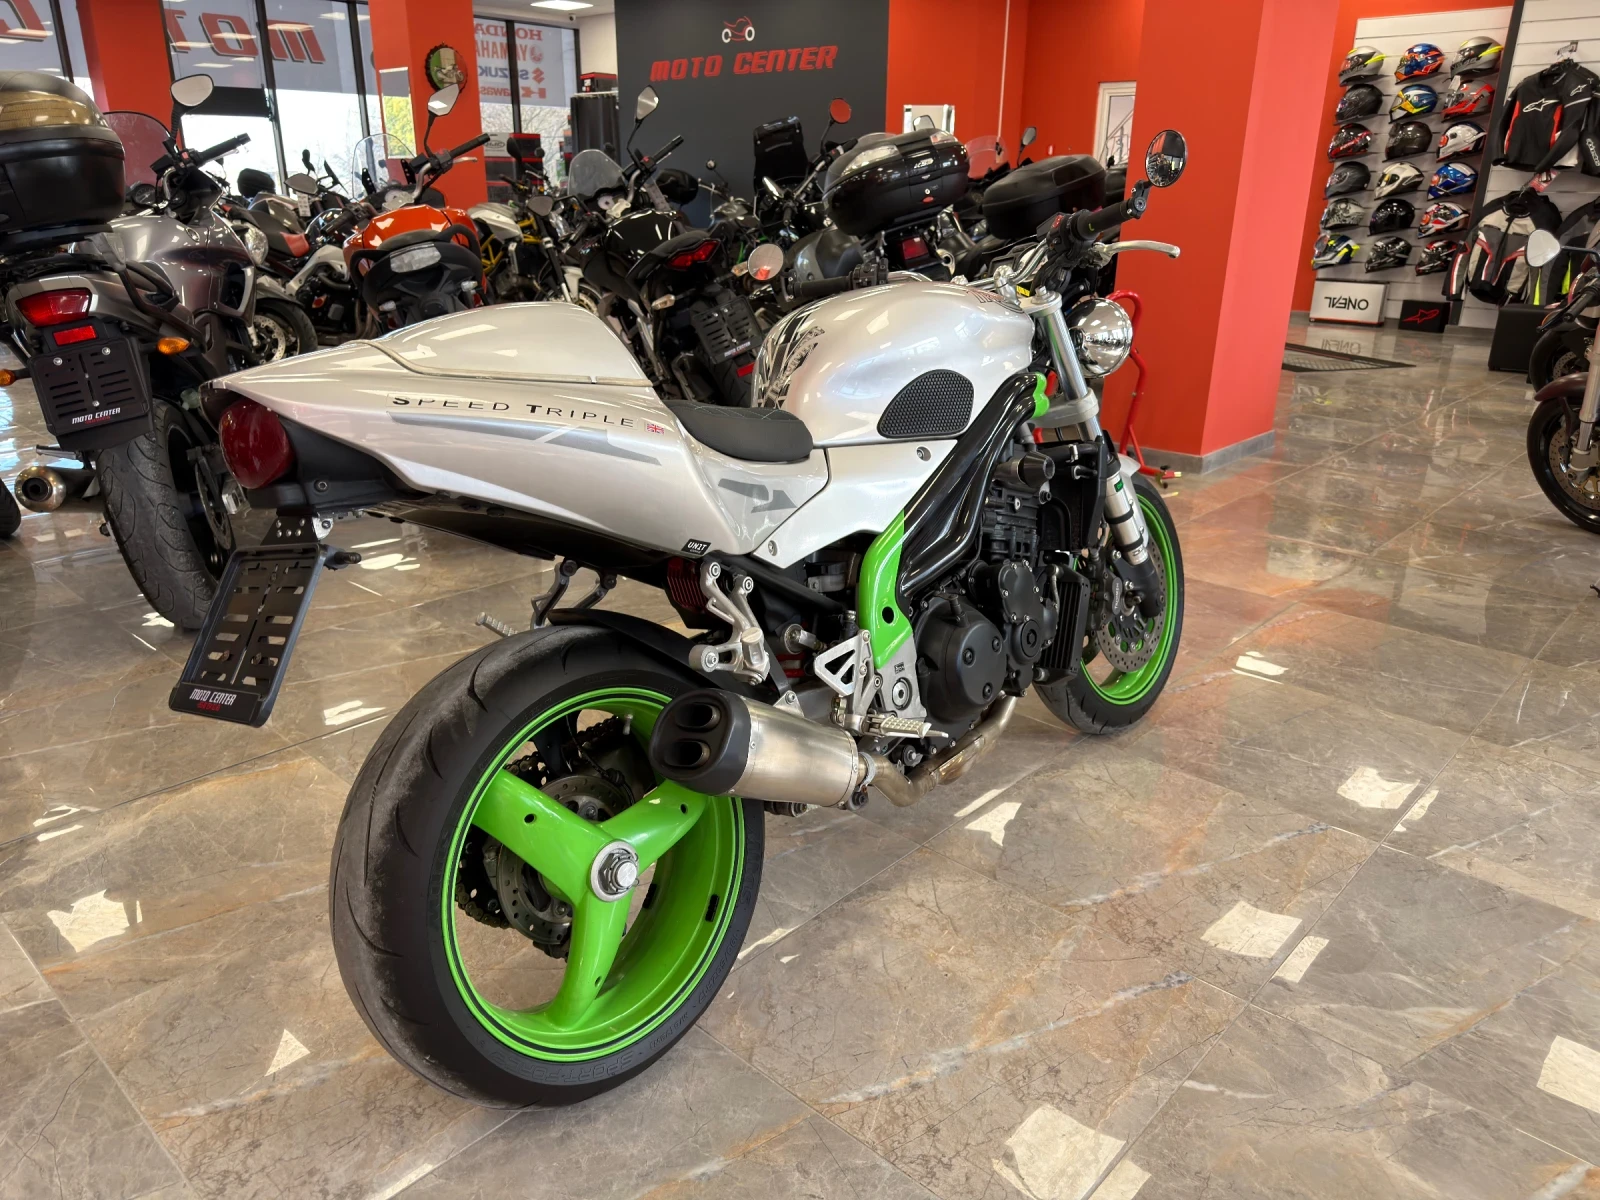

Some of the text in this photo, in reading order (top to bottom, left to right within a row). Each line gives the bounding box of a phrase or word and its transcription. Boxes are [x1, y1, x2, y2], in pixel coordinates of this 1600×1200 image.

[650, 45, 839, 82] MOTO CENTER
[72, 413, 93, 425] MOTO
[95, 407, 121, 419] CENTER
[391, 397, 635, 428] SPEED TRIPLE
[688, 541, 708, 551] UNIT
[189, 688, 237, 706] MOTO CENTER
